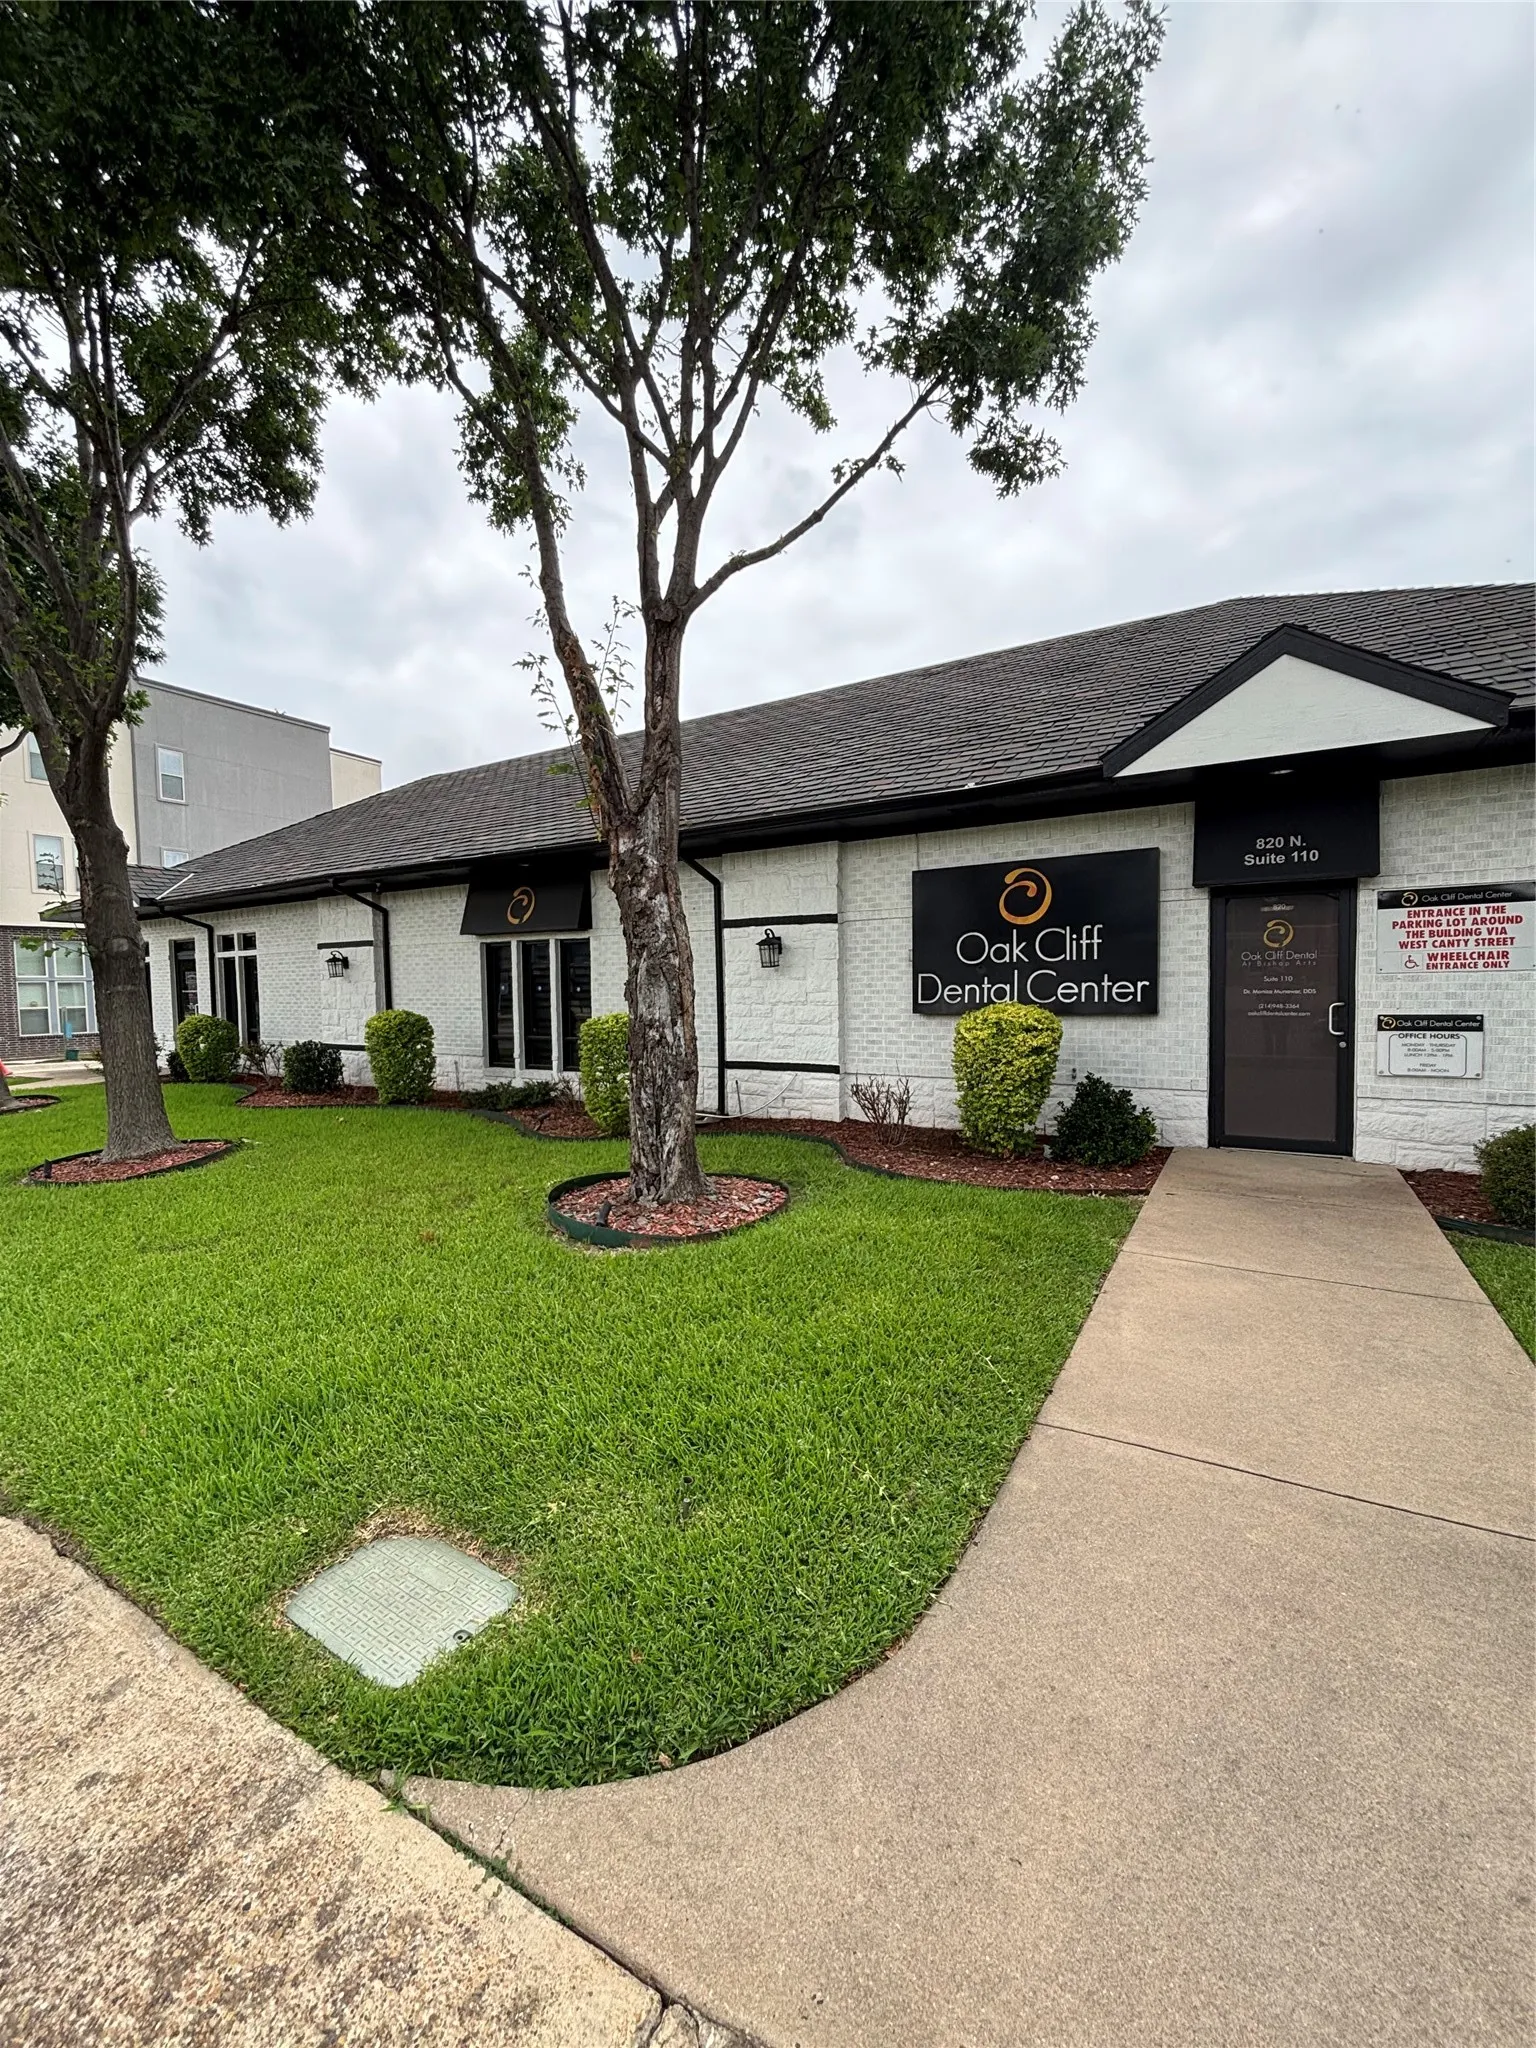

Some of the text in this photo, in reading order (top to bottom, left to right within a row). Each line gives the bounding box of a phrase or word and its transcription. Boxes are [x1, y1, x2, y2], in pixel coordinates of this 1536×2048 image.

[1256, 835, 1306, 849] 820 N.
[1244, 850, 1319, 865] Suite 110
[1421, 891, 1513, 902] Oak Cliff Dental Center
[1407, 905, 1507, 919] ENTRANCE IN THE
[1392, 915, 1523, 929] PARKING LOT AROUND
[1406, 926, 1508, 939] THE BUILDING VIA
[956, 924, 1103, 964] Oak Cliff
[1399, 937, 1516, 949] WEST CANTY STREET
[1241, 949, 1318, 961] Oak Cliff Dental
[1427, 950, 1510, 962] WHEELCHAIR
[1426, 960, 1510, 970] ENTRANCE ONLY
[918, 969, 1149, 1004] Dental Center
[1414, 1019, 1428, 1027] Cliff
[1429, 1019, 1453, 1027] Dental
